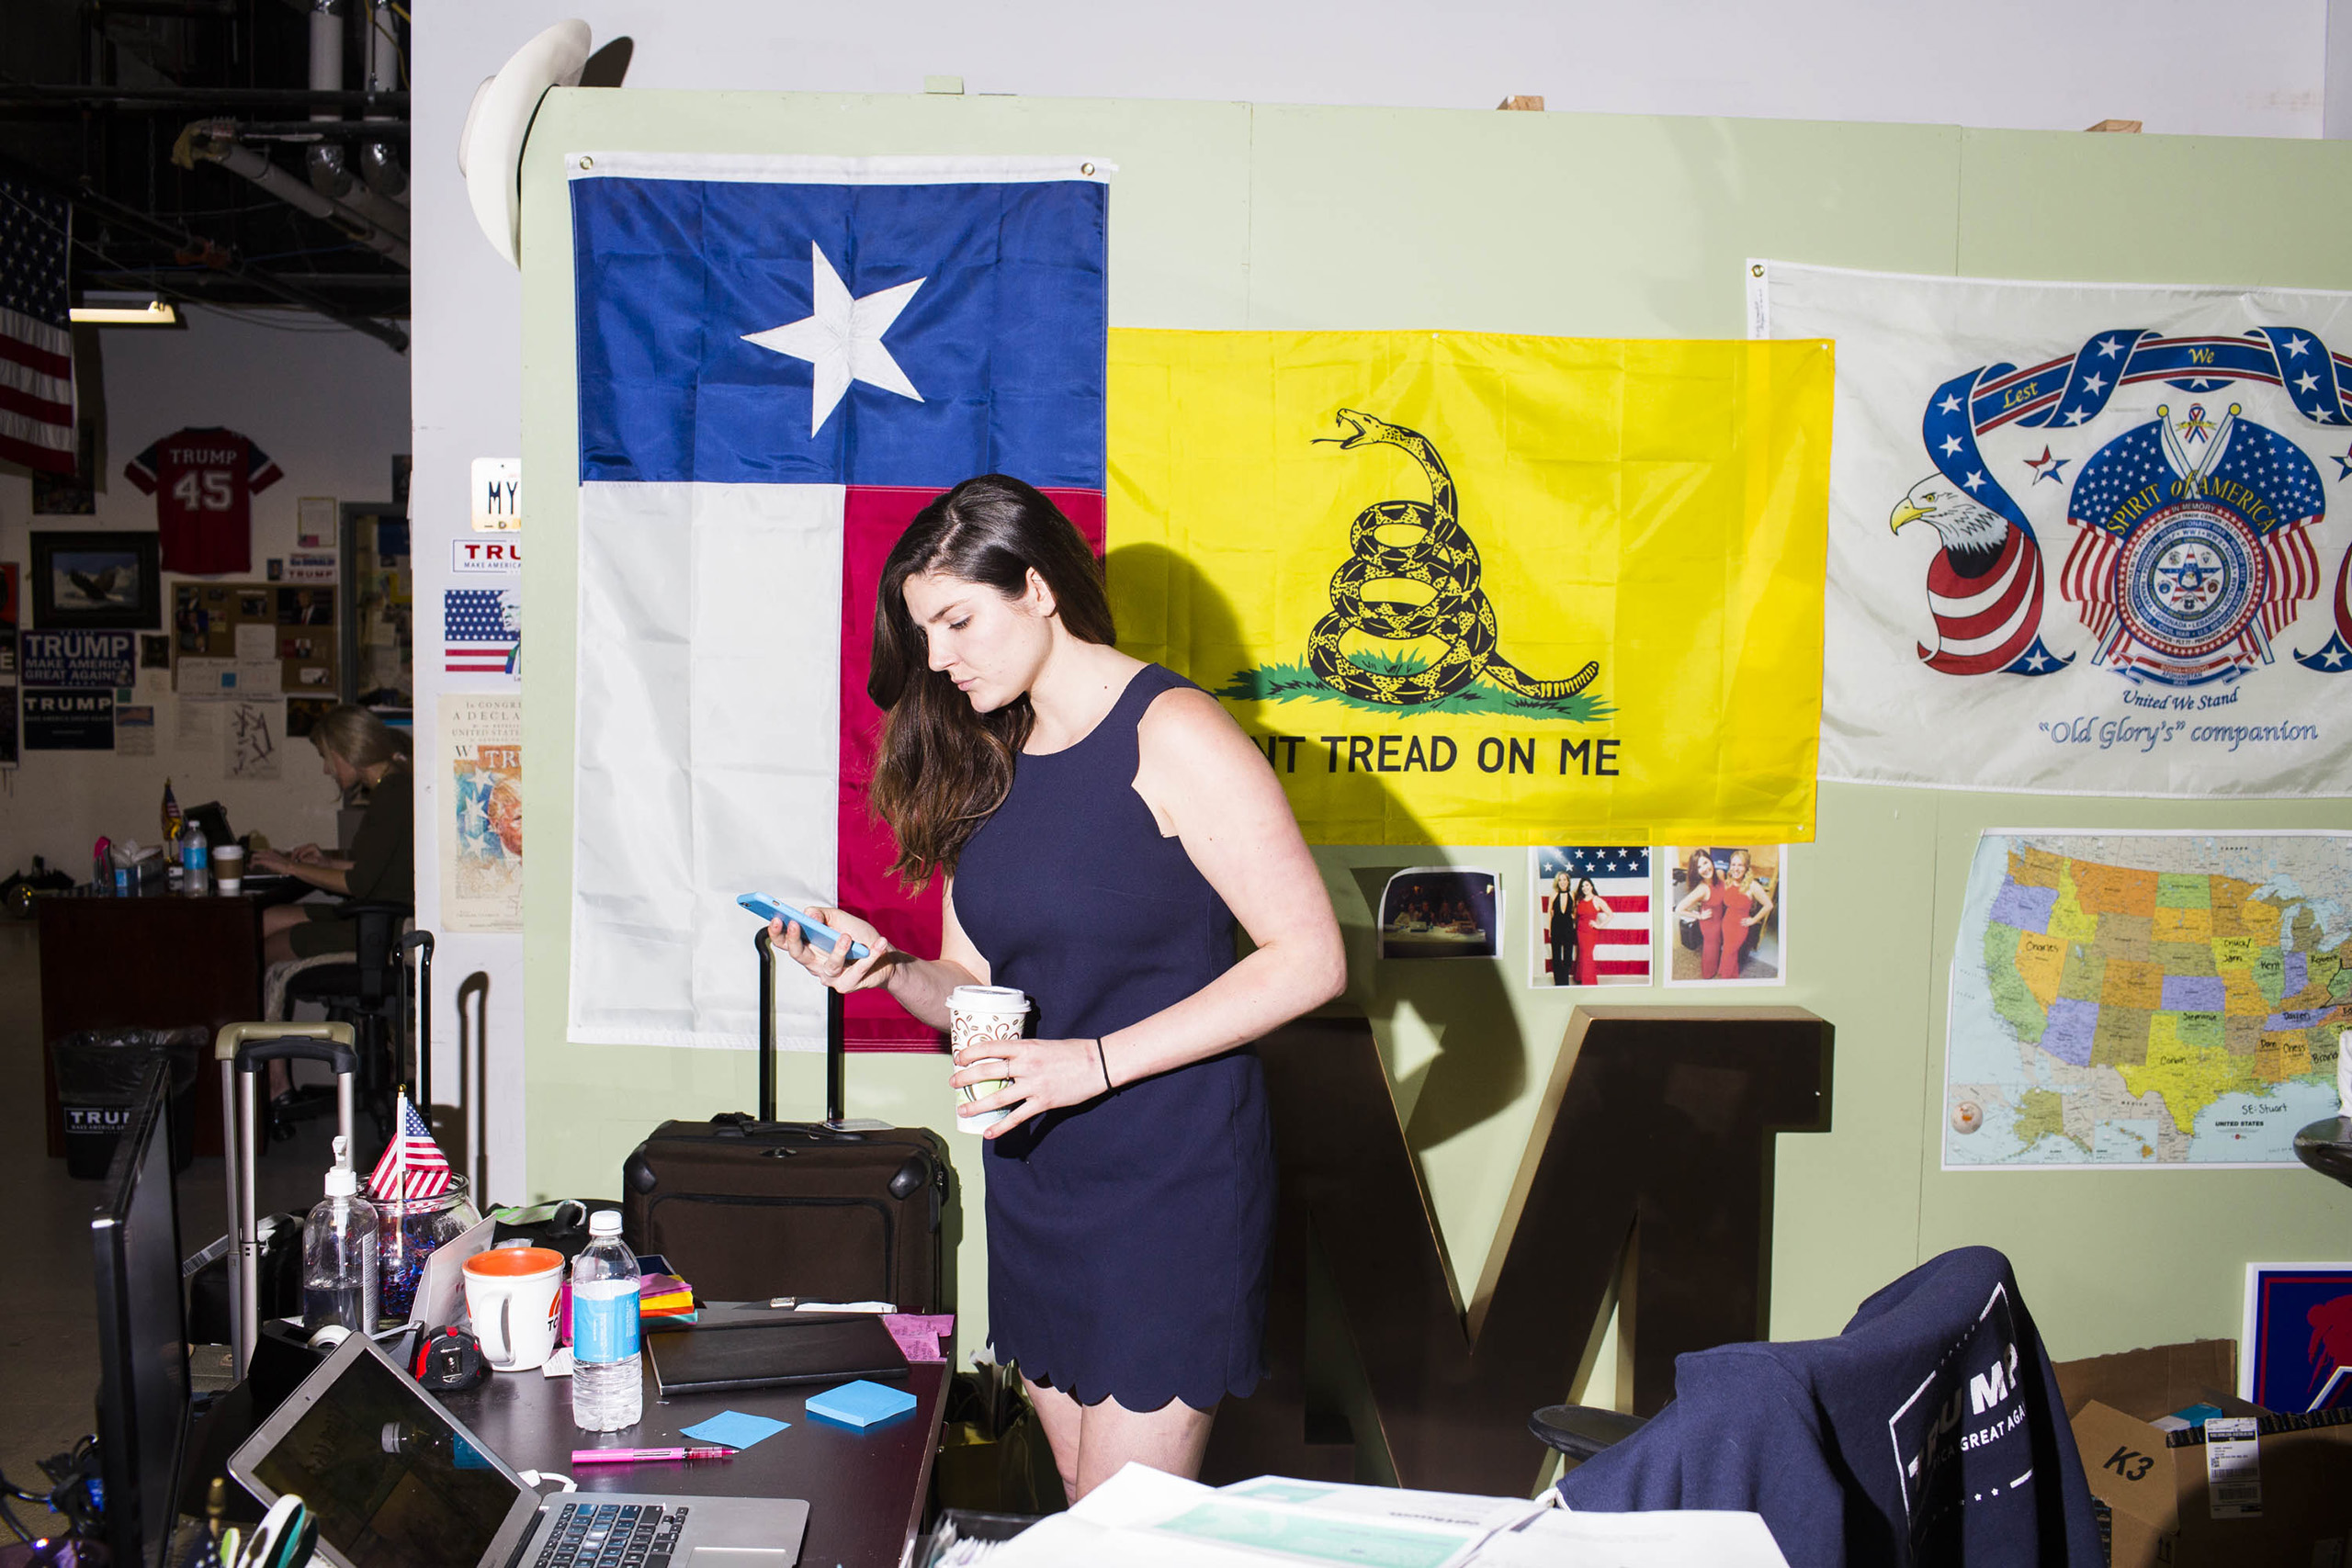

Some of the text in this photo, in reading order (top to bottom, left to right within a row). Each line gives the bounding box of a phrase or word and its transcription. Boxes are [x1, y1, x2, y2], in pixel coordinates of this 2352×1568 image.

[2188, 347, 2215, 365] We
[2003, 381, 2038, 409] Lest
[169, 448, 238, 465] TRUMP
[172, 469, 234, 512] 45
[2106, 468, 2277, 536] SPIRIT of AMERICA
[2171, 502, 2217, 514] IN MEMORY
[2200, 513, 2223, 524] CENTER
[2160, 519, 2211, 538] REVOLUTIONARY
[2182, 528, 2198, 536] WW
[2143, 533, 2176, 574] PERSIAN GULF
[2223, 544, 2237, 570] KOREA
[289, 570, 333, 579] TRUMP
[2141, 581, 2153, 609] PANAMA
[2223, 577, 2238, 607] VIETNAM
[2154, 611, 2188, 628] GRENADA
[2191, 609, 2222, 629] LEBANON
[2210, 603, 2234, 630] MEXICAN
[2157, 624, 2191, 637] CIVIL WAR
[2193, 627, 2222, 644] PENTAGON
[26, 635, 130, 659] TRUMP
[25, 659, 130, 670] MAKE AMERICA
[25, 670, 66, 681] GREAT
[24, 696, 112, 712] TRUMP
[2123, 685, 2241, 710] United We Stand
[2190, 720, 2318, 752] companion
[1320, 734, 1458, 773] TREAD
[1476, 737, 1535, 774] ON
[1559, 738, 1621, 776] ME
[2025, 940, 2059, 953] Charles
[2260, 960, 2280, 971] Kent
[2311, 953, 2338, 964] Robert
[2258, 1102, 2288, 1114] Stuart
[2215, 1120, 2265, 1128] UNITED STATES
[1907, 1342, 2019, 1494] TRUMP
[1960, 1420, 2006, 1452] GREAT
[2103, 1446, 2154, 1481] K3
